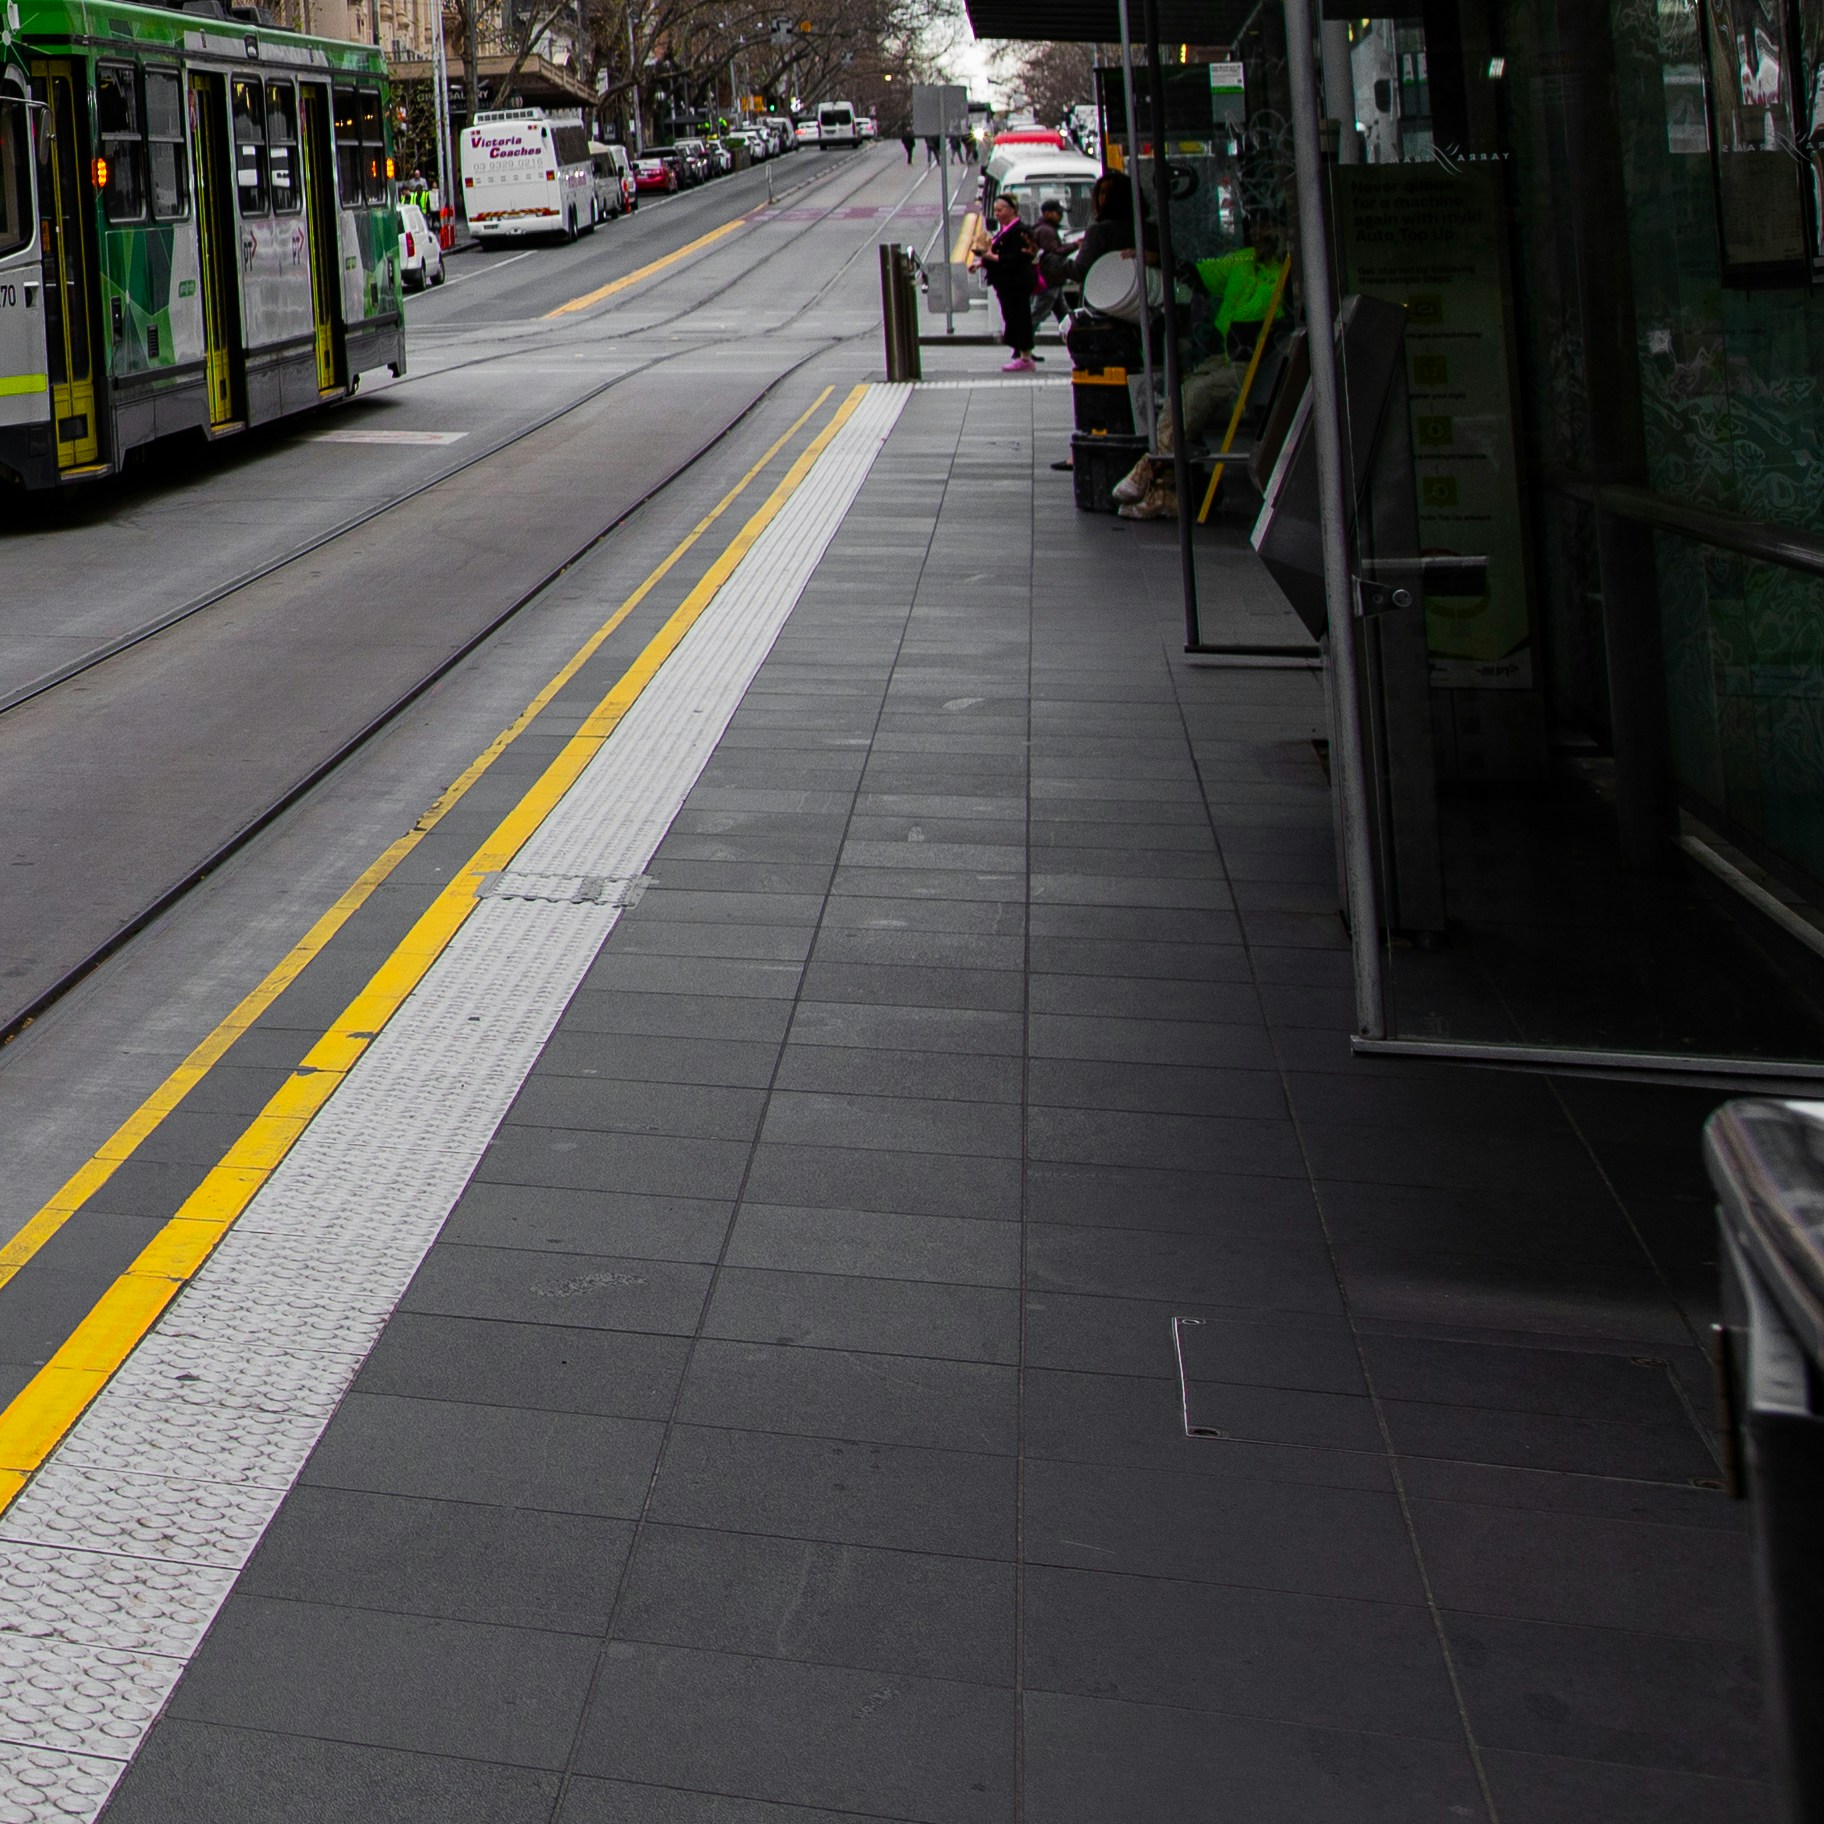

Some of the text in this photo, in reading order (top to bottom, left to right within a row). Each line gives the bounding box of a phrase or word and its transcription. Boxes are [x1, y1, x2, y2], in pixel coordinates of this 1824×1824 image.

[471, 135, 522, 149] Victoria
[490, 146, 542, 158] Coaches
[1352, 179, 1455, 194] Never queue
[1354, 196, 1375, 209] for
[1395, 194, 1463, 209] machine
[1355, 213, 1398, 229] again
[1402, 210, 1437, 224] with
[1356, 226, 1455, 244] Auto Top Up
